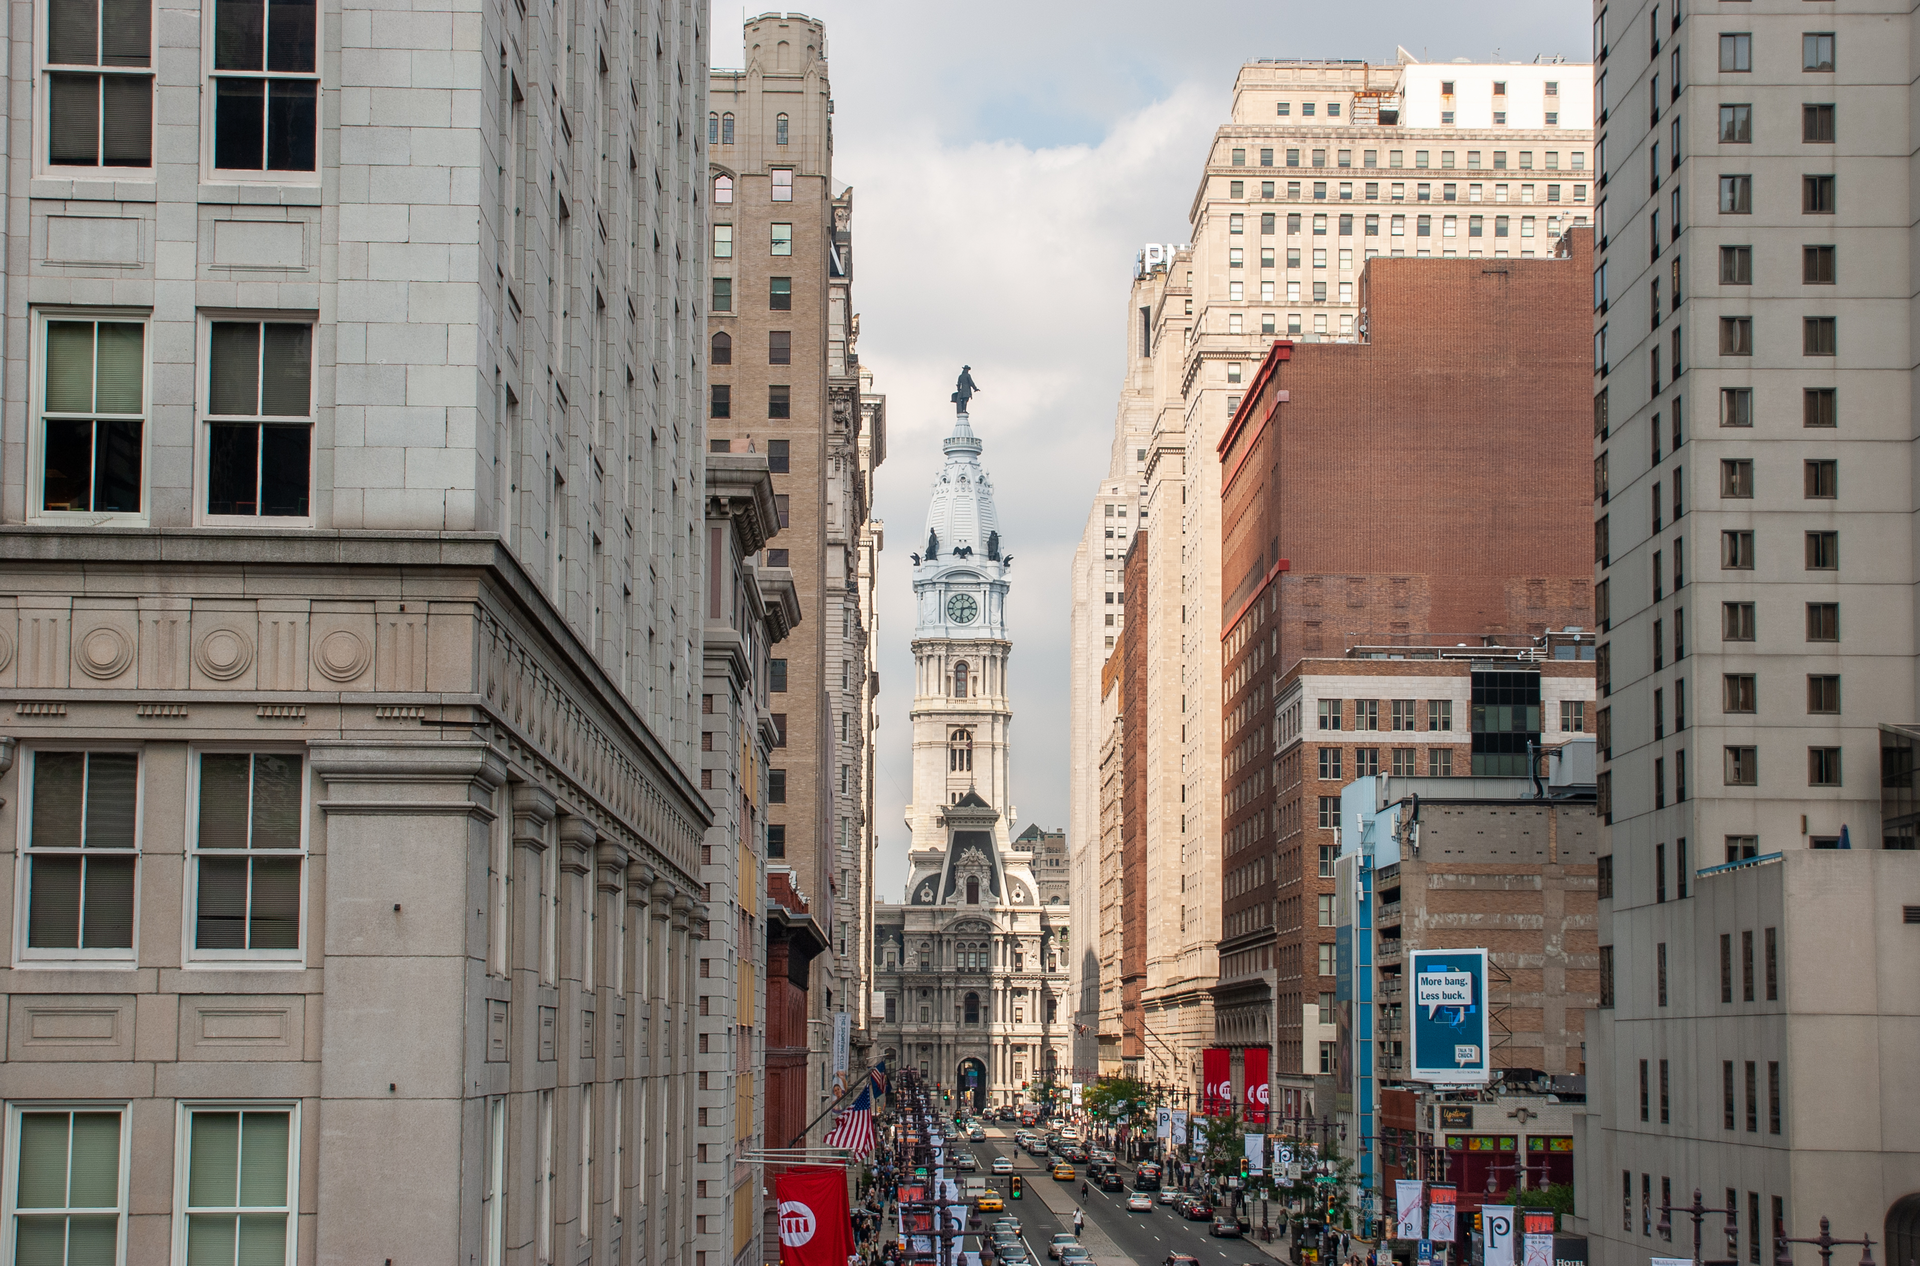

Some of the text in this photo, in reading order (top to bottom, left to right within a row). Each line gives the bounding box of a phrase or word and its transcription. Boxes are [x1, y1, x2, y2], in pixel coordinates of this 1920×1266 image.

[1421, 976, 1468, 987] More bang.
[1421, 991, 1465, 1000] Less buck.
[1421, 1243, 1430, 1252] H
